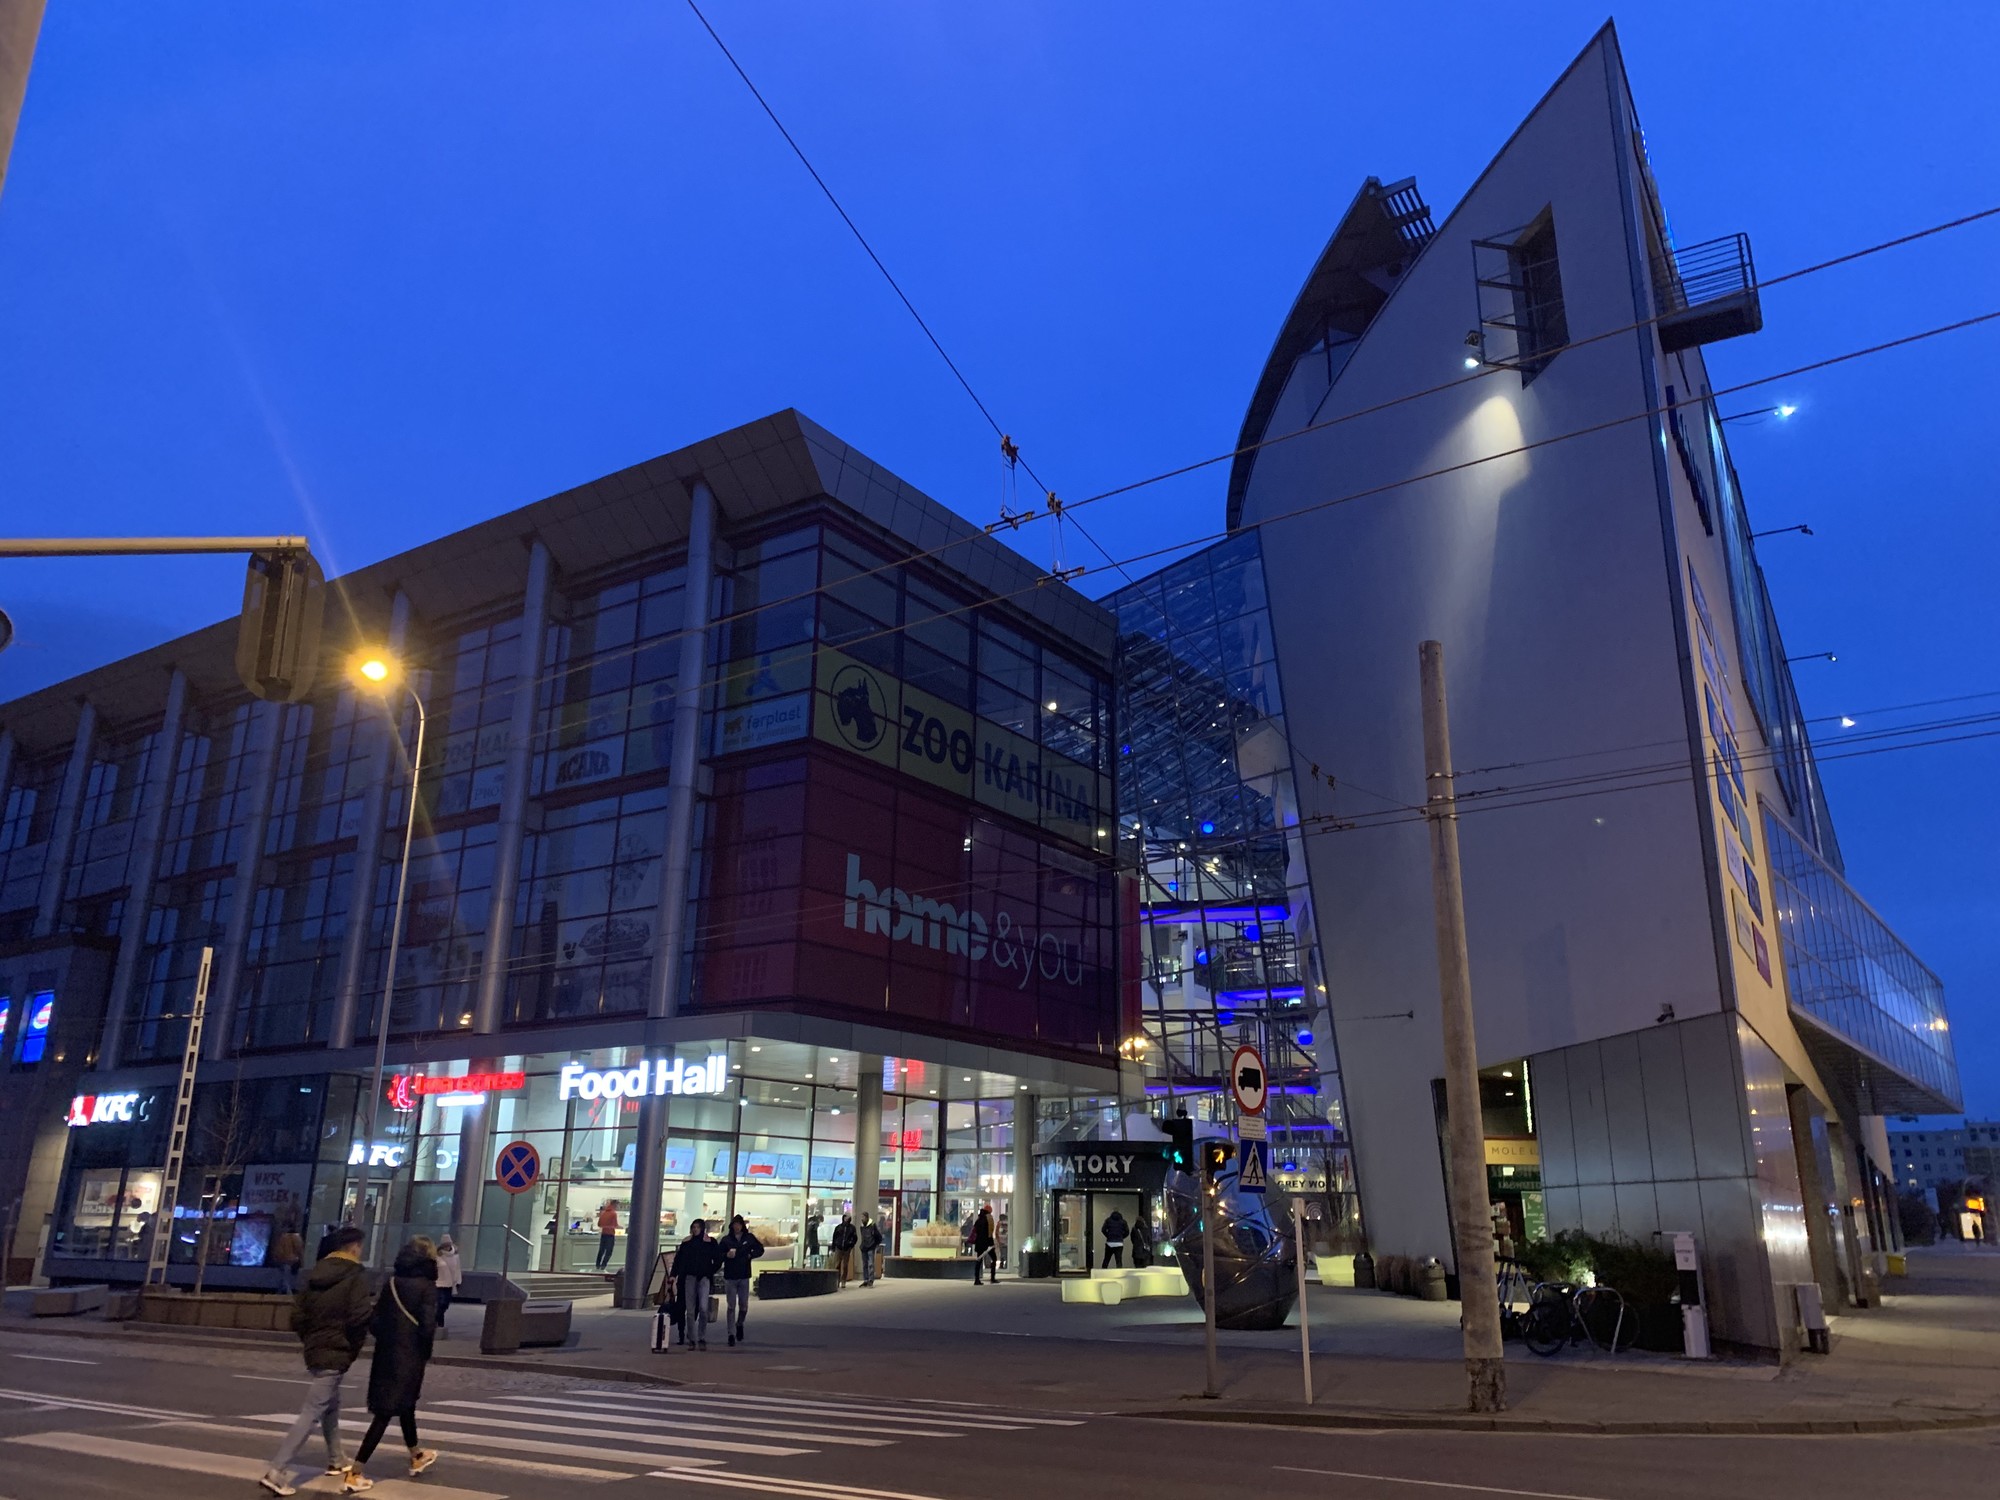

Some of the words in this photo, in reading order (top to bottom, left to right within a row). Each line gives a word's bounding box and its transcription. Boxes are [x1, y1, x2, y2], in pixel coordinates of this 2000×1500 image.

[746, 704, 801, 730] ferplast
[902, 704, 973, 775] ZOO
[984, 742, 1091, 821] KARINA
[559, 1060, 650, 1101] Food
[654, 1054, 727, 1096] Hall
[91, 1093, 139, 1122] KFC
[1056, 1154, 1135, 1174] BATORY
